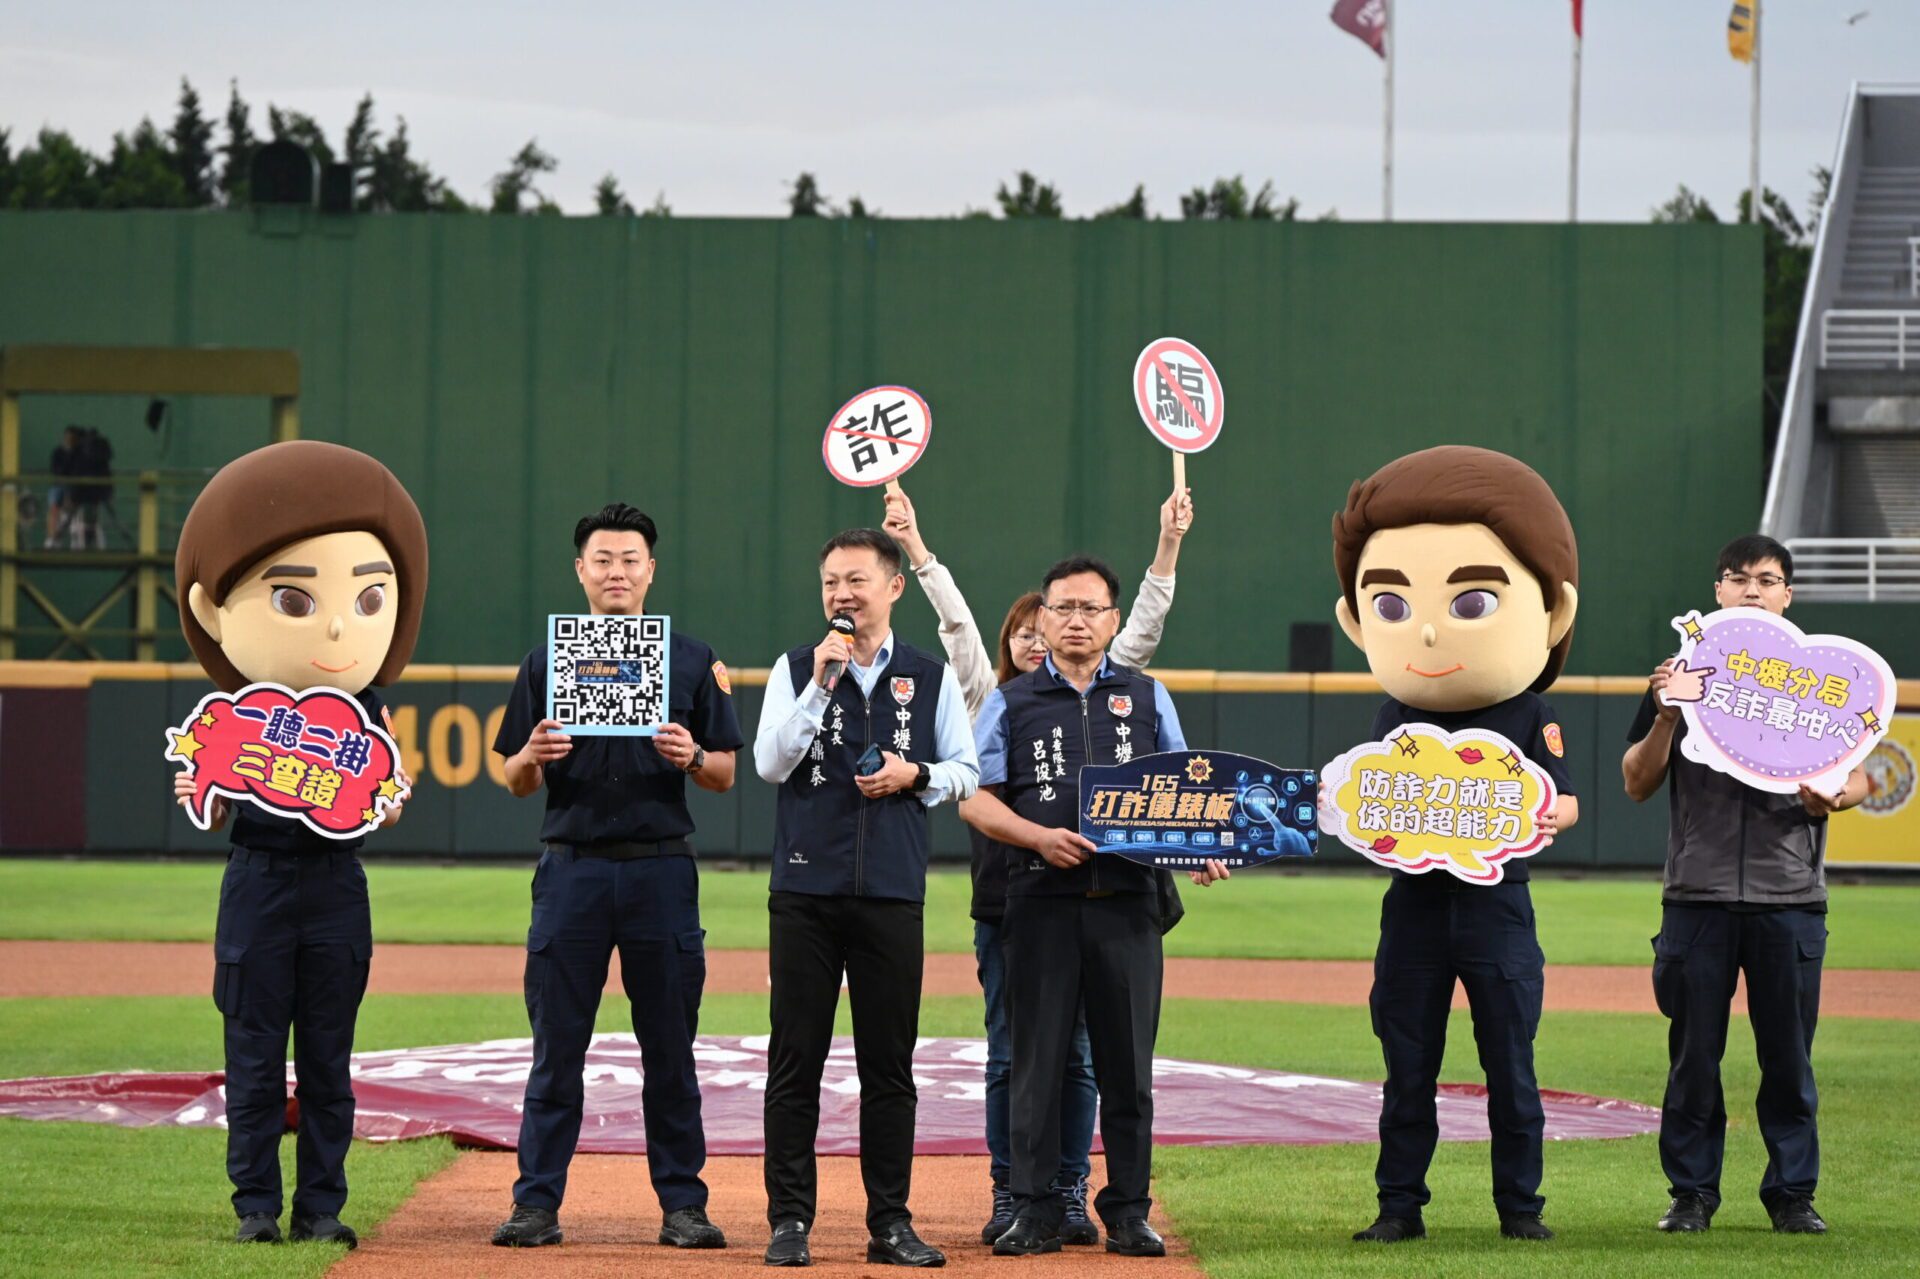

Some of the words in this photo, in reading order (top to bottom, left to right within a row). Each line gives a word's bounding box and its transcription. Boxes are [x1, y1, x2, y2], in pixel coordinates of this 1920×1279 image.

[1155, 361, 1206, 430] 騙
[841, 399, 913, 473] 詐
[1726, 649, 1851, 709] 中壢分局
[233, 705, 373, 777] 一聽二掛
[831, 703, 845, 746] 分局長
[892, 706, 912, 763] 中壢
[1114, 722, 1134, 763] 中壢
[1701, 680, 1859, 749] 反詐最咁心
[231, 742, 343, 809] 三查證
[1032, 739, 1057, 802] 呂俊池
[1051, 725, 1067, 778] 偵查隊長
[1090, 790, 1236, 820] 打詐儀錶板
[1141, 774, 1181, 792] 165
[1358, 768, 1524, 811] 防詐力就是
[1356, 801, 1522, 843] 你的超能力
